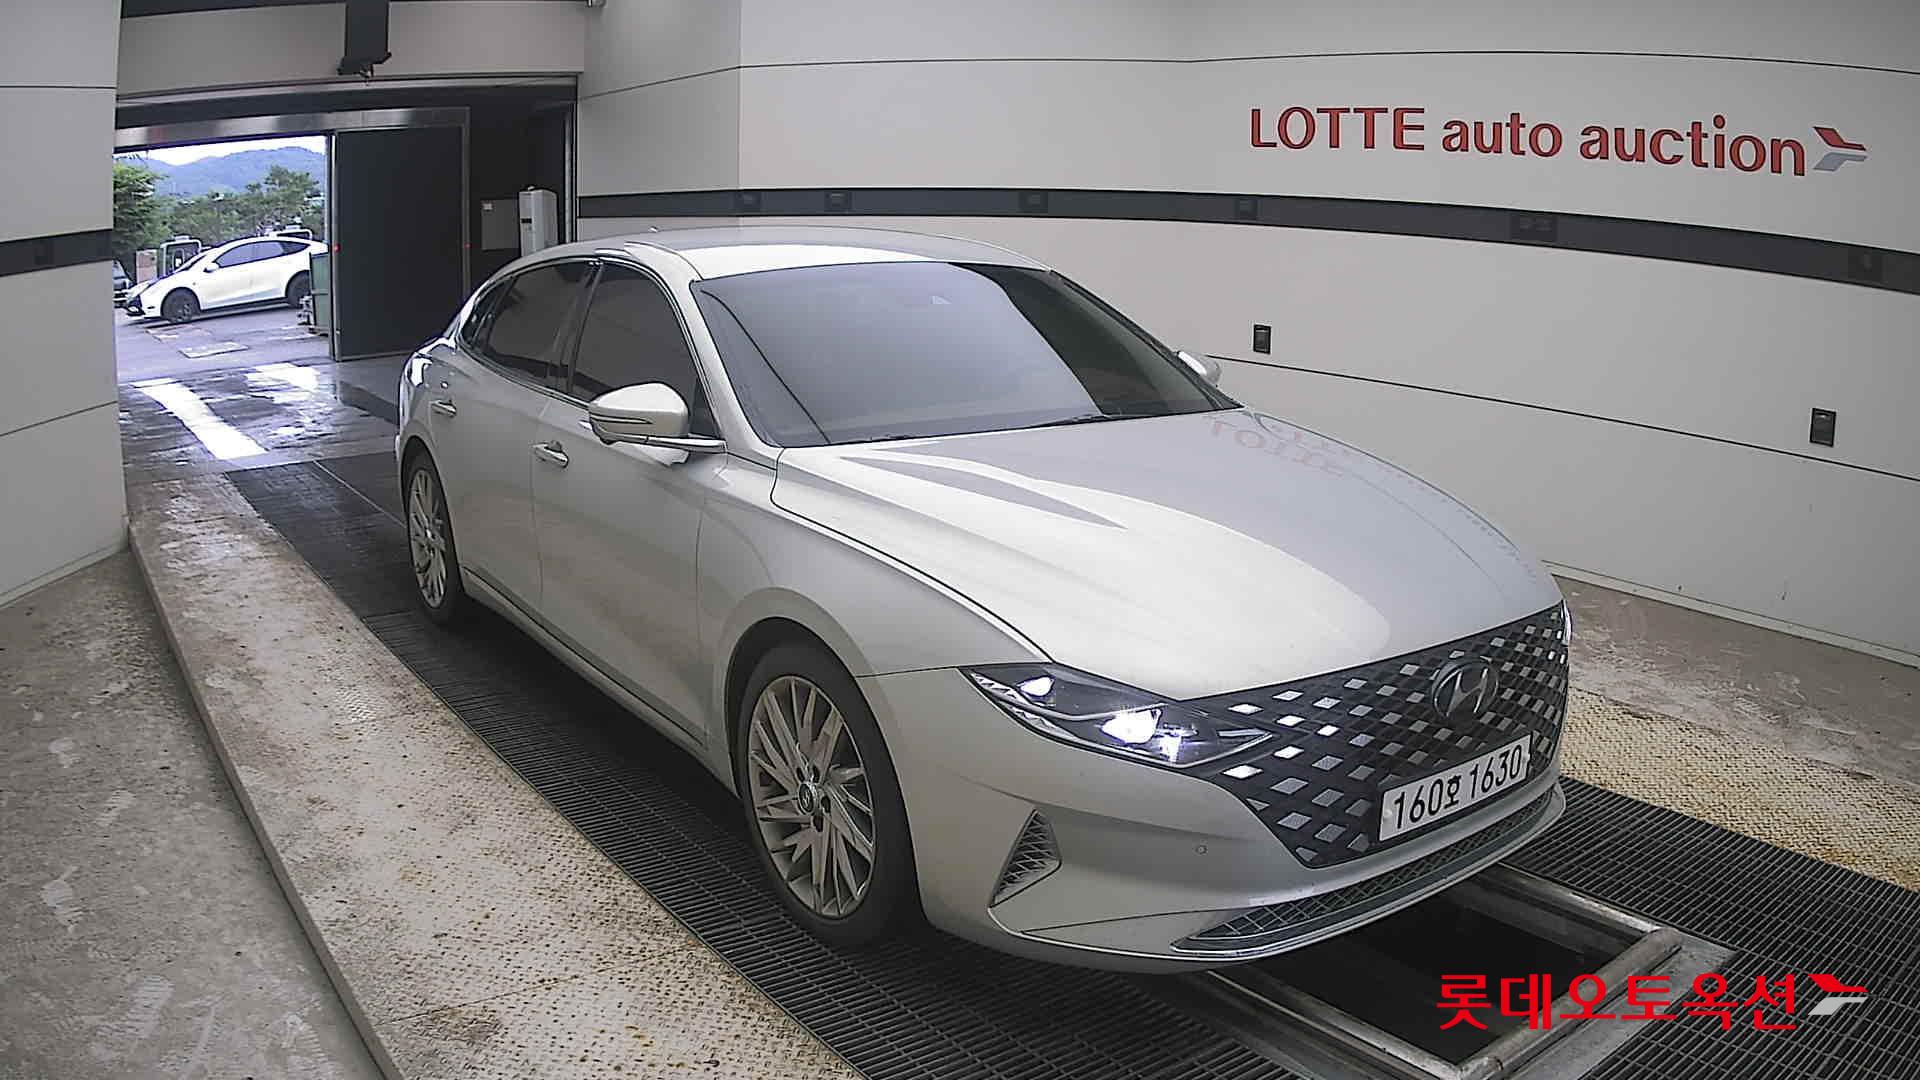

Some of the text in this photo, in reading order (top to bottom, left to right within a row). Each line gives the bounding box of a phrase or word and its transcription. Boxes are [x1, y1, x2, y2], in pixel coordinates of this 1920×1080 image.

[1251, 107, 1806, 177] LOTTE auto auction
[1394, 745, 1523, 829] 160호 1630
